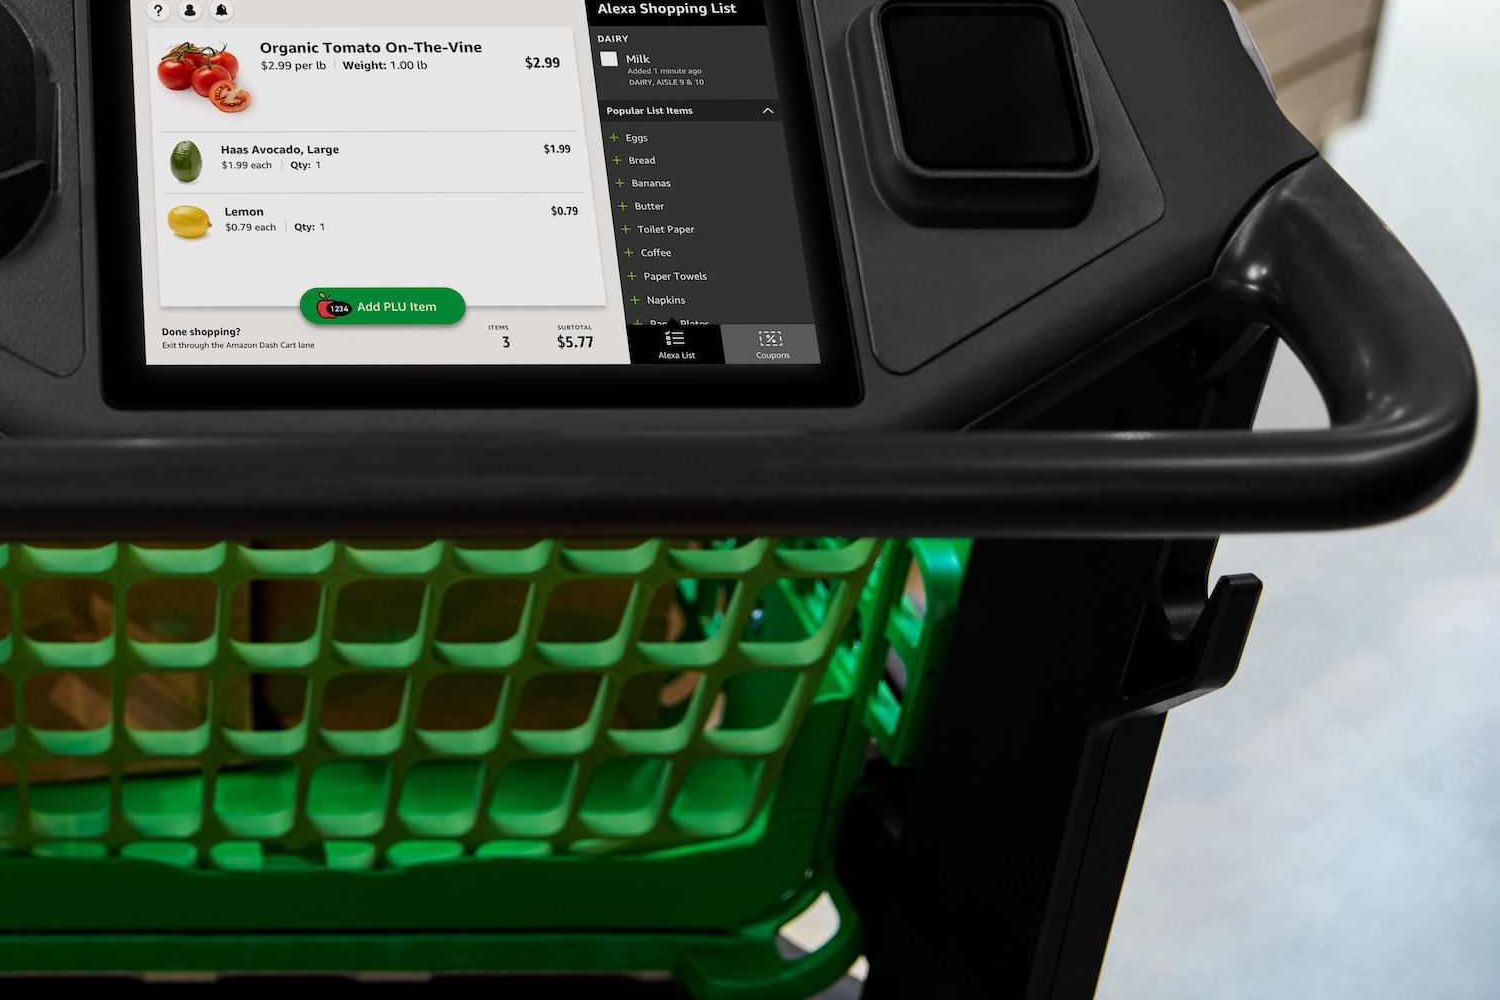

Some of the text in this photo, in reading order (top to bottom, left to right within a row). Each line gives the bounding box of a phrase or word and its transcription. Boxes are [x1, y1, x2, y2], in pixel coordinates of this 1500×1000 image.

[598, 3, 736, 16] Alexa Shopping List
[260, 41, 482, 57] Organic Tomato On-The-Vine
[525, 55, 561, 70] $2.99
[626, 55, 650, 63] Milk
[260, 60, 428, 72] $2.99 per lb Weight: 1.00 lb
[627, 67, 652, 75] Added
[687, 68, 703, 76] ago
[628, 78, 705, 86] DAIRY, AISLE 9 & 10
[607, 107, 644, 116] Popular
[626, 134, 648, 143] Eggs
[221, 144, 340, 157] Haas Avocado, Large
[543, 143, 571, 155] $1.99
[628, 155, 656, 165] Bread
[221, 160, 321, 171] $1.99 each Qty: 1
[631, 178, 672, 188] Bananas
[224, 207, 264, 217] Lemon
[550, 205, 579, 217] $0.79
[634, 203, 664, 211] Butter
[225, 222, 325, 233] $0.79 each Qty: 1
[637, 225, 694, 235] Toilet Paper
[641, 248, 671, 257] Coffee
[644, 272, 707, 282] Paper Towels
[647, 296, 685, 306] Napkins
[357, 301, 437, 312] Add PLU Item
[161, 327, 241, 338] Done shopping?
[162, 341, 315, 351] Exit through the Amazon Dash Cart lane
[502, 335, 511, 349] 3
[557, 334, 594, 350] $5.77
[756, 352, 790, 360] Coupons
